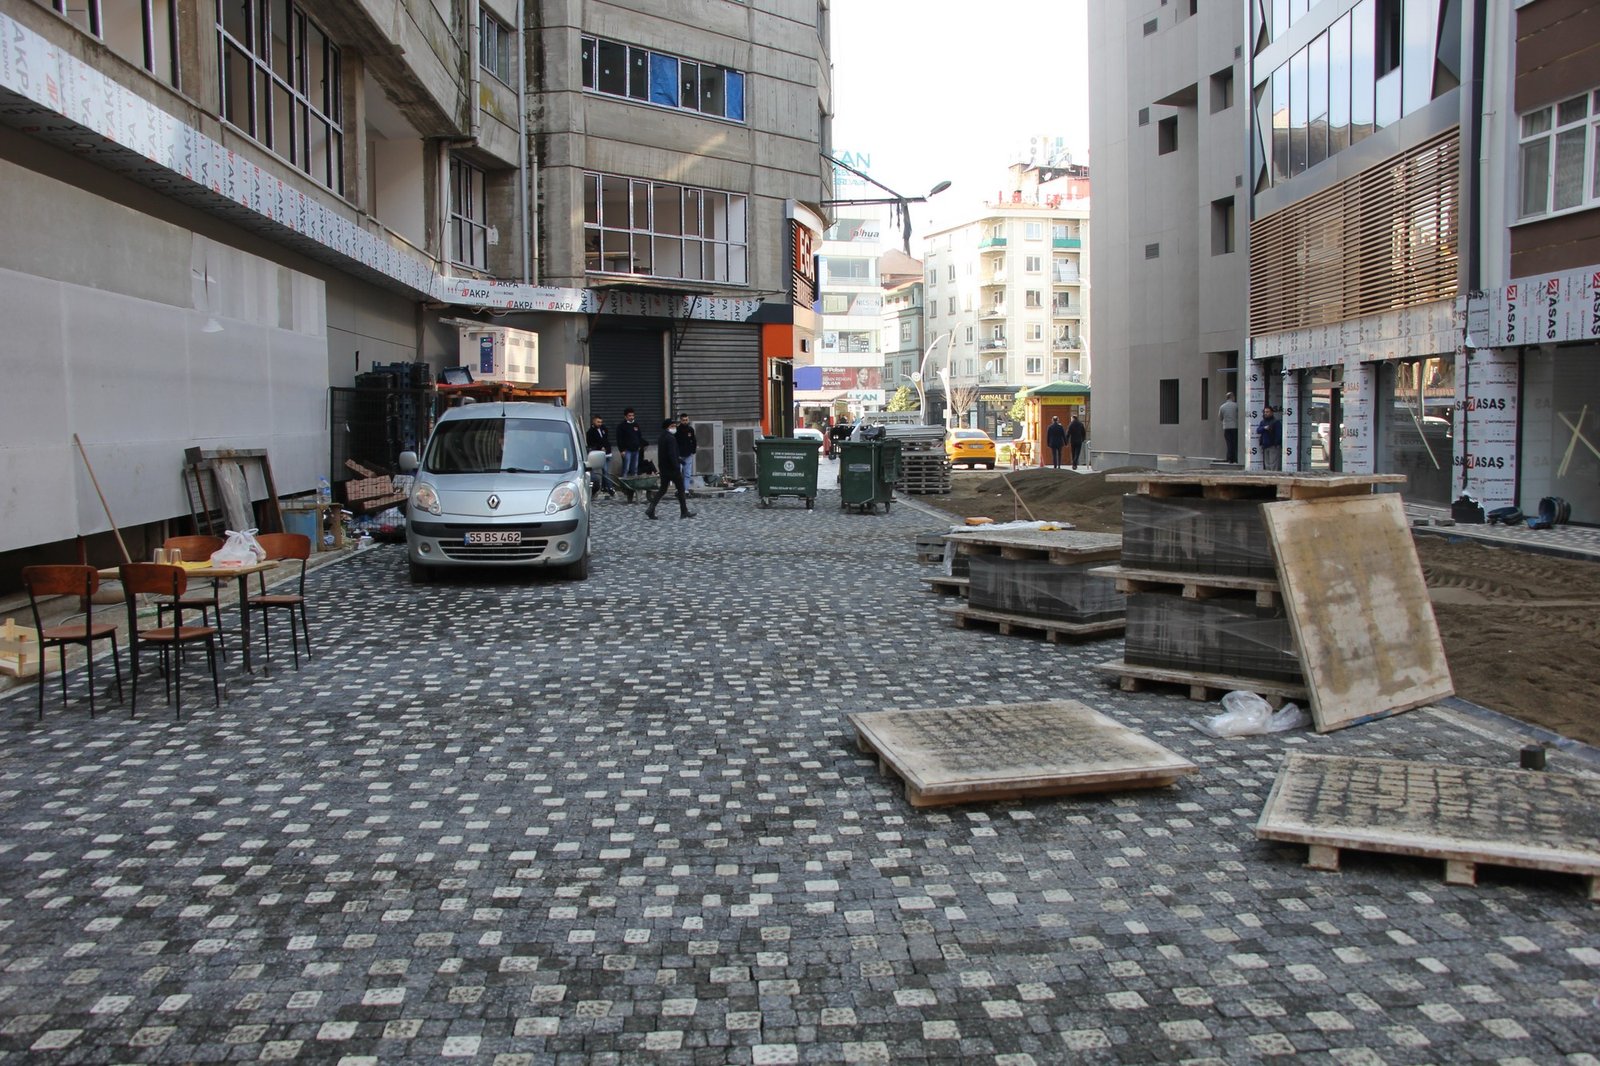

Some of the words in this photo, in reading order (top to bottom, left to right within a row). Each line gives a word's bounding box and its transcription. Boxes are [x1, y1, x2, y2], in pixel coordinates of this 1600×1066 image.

[1507, 303, 1516, 343] ASAŞ
[1547, 297, 1557, 339] ASAŞ
[1476, 398, 1506, 411] ASAŞ
[1475, 456, 1504, 469] ASAŞ
[470, 532, 482, 542] 55
[484, 532, 498, 542] BS
[500, 532, 520, 542] 462
